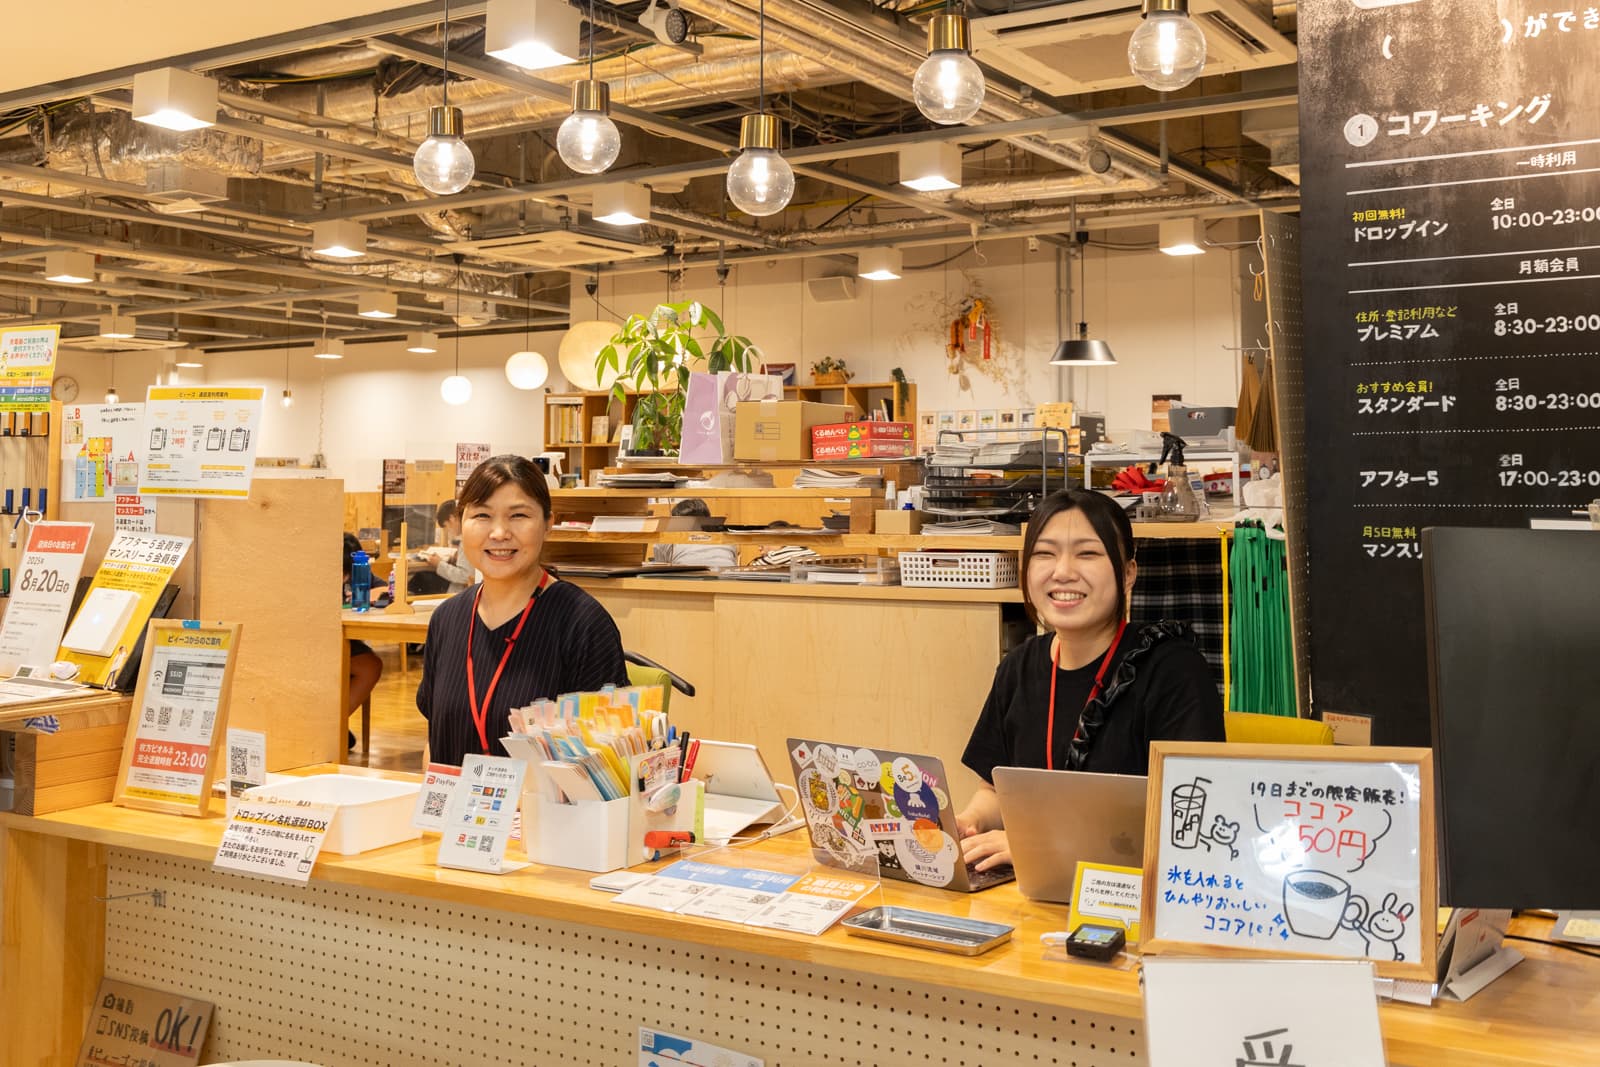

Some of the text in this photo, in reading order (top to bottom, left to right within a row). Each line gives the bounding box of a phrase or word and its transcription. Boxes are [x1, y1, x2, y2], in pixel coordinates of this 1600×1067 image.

[1388, 94, 1551, 136] コワーキング
[1516, 151, 1577, 168] 一時利用
[1491, 197, 1515, 210] 全日
[1354, 220, 1449, 242] ドロップイン
[1519, 258, 1579, 274] 月額会員
[1494, 302, 1519, 316] 全日
[1357, 323, 1440, 342] プレミアム
[1494, 314, 1600, 336] 8:30-23:00
[1495, 378, 1520, 391] 全日
[1358, 395, 1457, 414] スタンダード
[1495, 392, 1600, 411] 8:30-23:00
[1499, 454, 1523, 467] 全日
[1359, 470, 1440, 488] アフター5
[1362, 526, 1417, 539] 月5日無料
[173, 750, 207, 768] 23:00
[435, 778, 457, 787] PayPay
[1283, 800, 1354, 823] ココア
[1167, 864, 1244, 890] 氷を入れると
[1164, 889, 1267, 912] ひんやりおいしい
[154, 1005, 203, 1053] OK!
